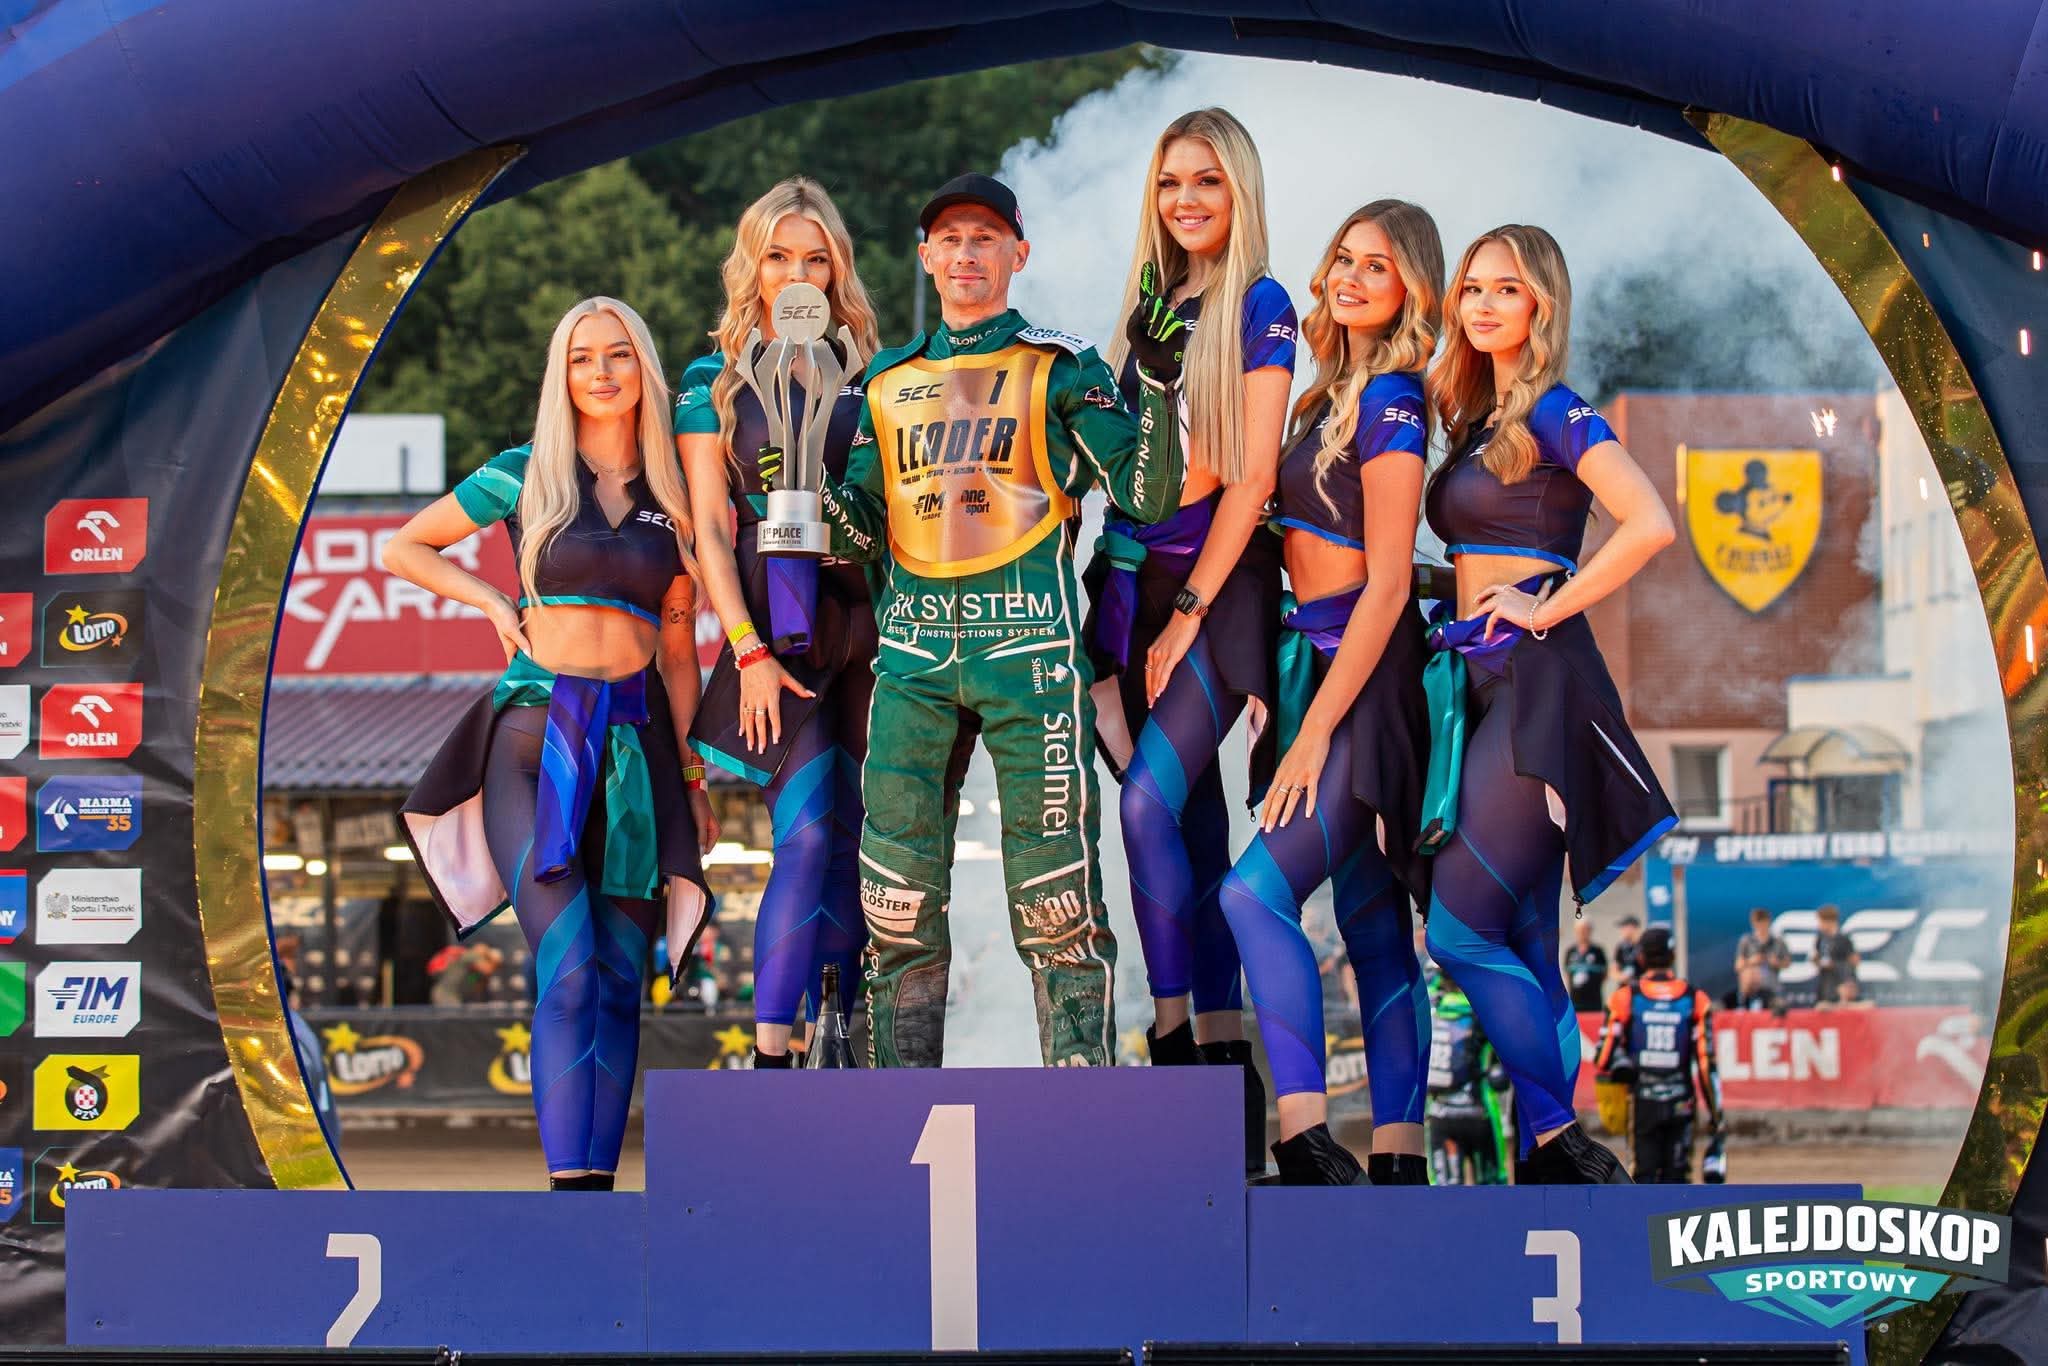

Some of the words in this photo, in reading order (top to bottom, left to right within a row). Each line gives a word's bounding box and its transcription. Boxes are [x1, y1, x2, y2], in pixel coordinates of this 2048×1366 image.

[779, 305, 821, 320] SEC
[895, 383, 944, 404] SEC
[988, 370, 1008, 405] 1
[897, 416, 1018, 473] LEADER
[914, 491, 945, 515] FIM
[961, 488, 985, 503] one
[965, 502, 990, 516] sport
[772, 527, 802, 539] PLACE
[71, 547, 122, 562] ORLEN
[921, 592, 1054, 620] SYSTEM
[73, 620, 115, 644] LOTTO
[1007, 627, 1056, 638] SYSTEM
[1031, 657, 1045, 695] Stelmet
[65, 732, 118, 747] ORLEN
[1042, 711, 1076, 838] Stelmet
[79, 797, 132, 808] MARMA
[106, 815, 131, 832] 35
[71, 895, 120, 903] Ministerstwo
[71, 904, 96, 914] Sportu
[102, 904, 135, 914] Turystyki
[1771, 909, 1988, 982] SEC
[52, 976, 129, 1010] FIM
[73, 1014, 118, 1024] EUROPE
[909, 1103, 979, 1352] 1
[325, 1233, 382, 1348] 2
[1525, 1230, 1582, 1344] 3
